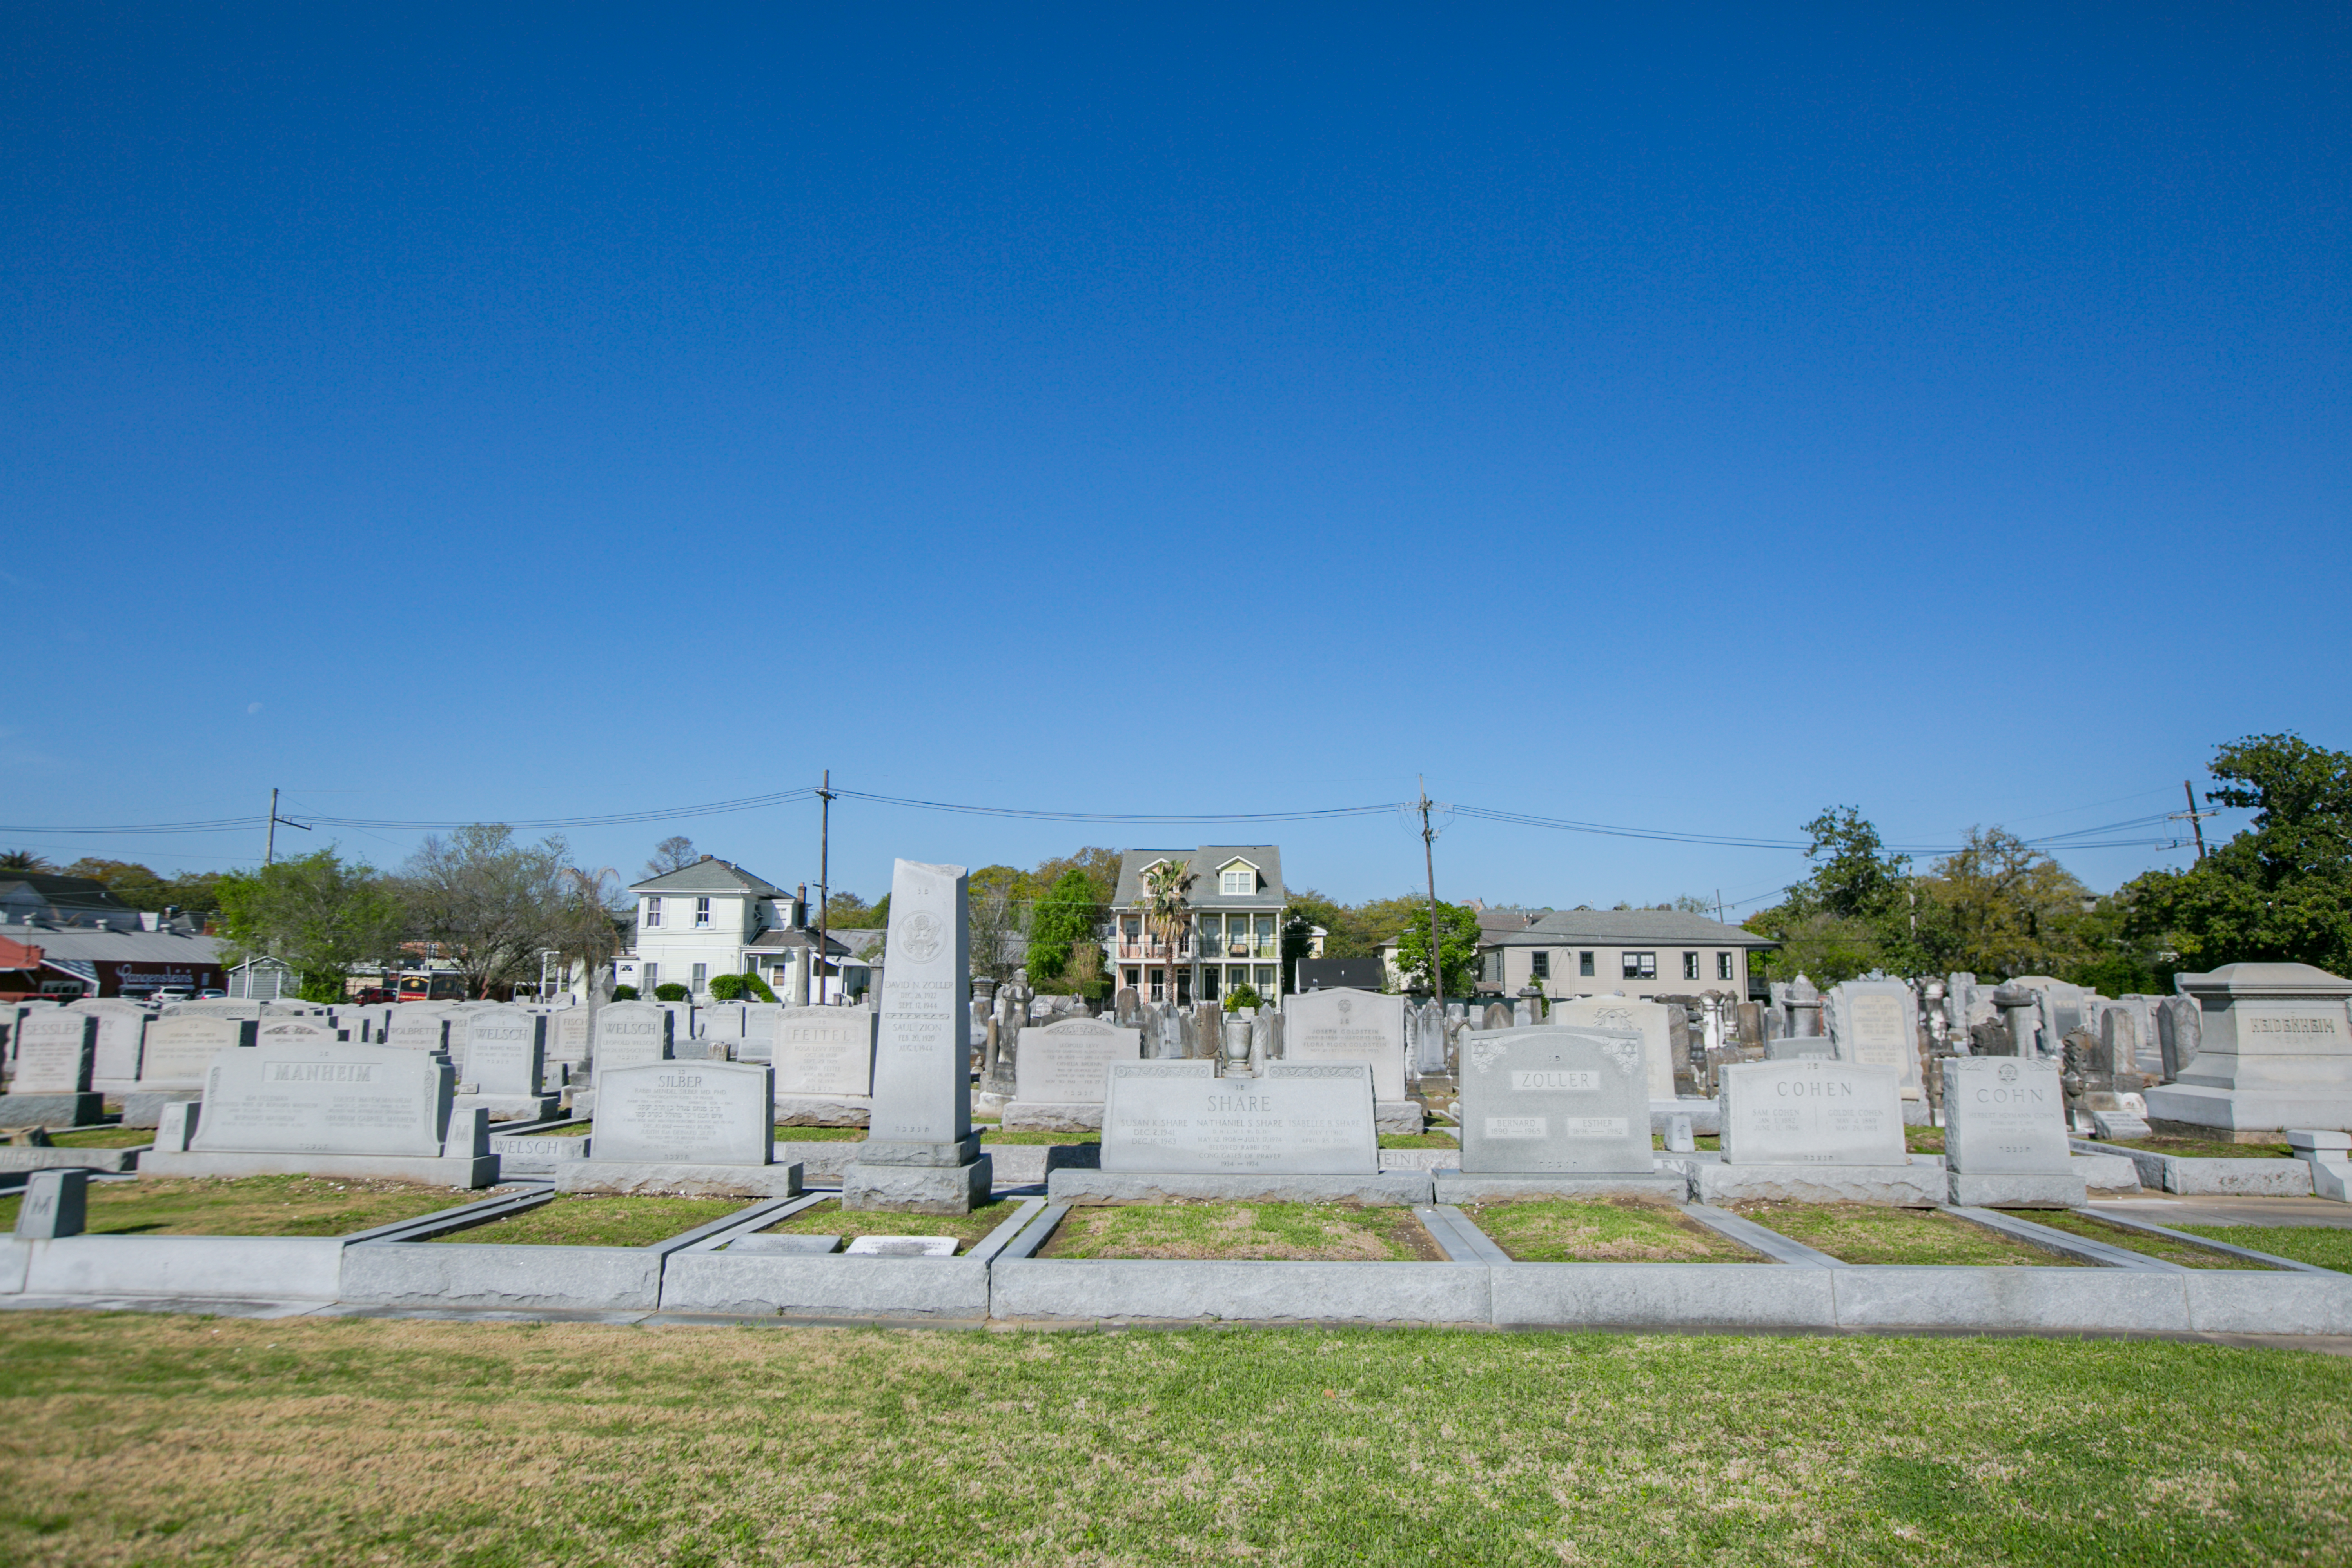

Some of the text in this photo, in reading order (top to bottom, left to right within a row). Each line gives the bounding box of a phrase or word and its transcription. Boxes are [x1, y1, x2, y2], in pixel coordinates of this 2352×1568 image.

[604, 1023, 657, 1035] WELSCH
[892, 1024, 942, 1032] SAUL ZION
[2250, 1018, 2336, 1033] HEIDENHEIM
[475, 1028, 528, 1041] WELSCH
[793, 1029, 851, 1041] FEITEL
[274, 1064, 371, 1082] MANHEIM
[1521, 1073, 1590, 1087] ZOLLER
[658, 1075, 702, 1088] SILBER
[1777, 1082, 1851, 1096] COHEN
[1976, 1089, 2043, 1103] COHN
[1207, 1095, 1272, 1112] SHARE
[454, 1124, 470, 1141] M
[495, 1140, 559, 1154] WELSCH
[1384, 1153, 1411, 1165] EIN
[30, 1196, 54, 1215] M
